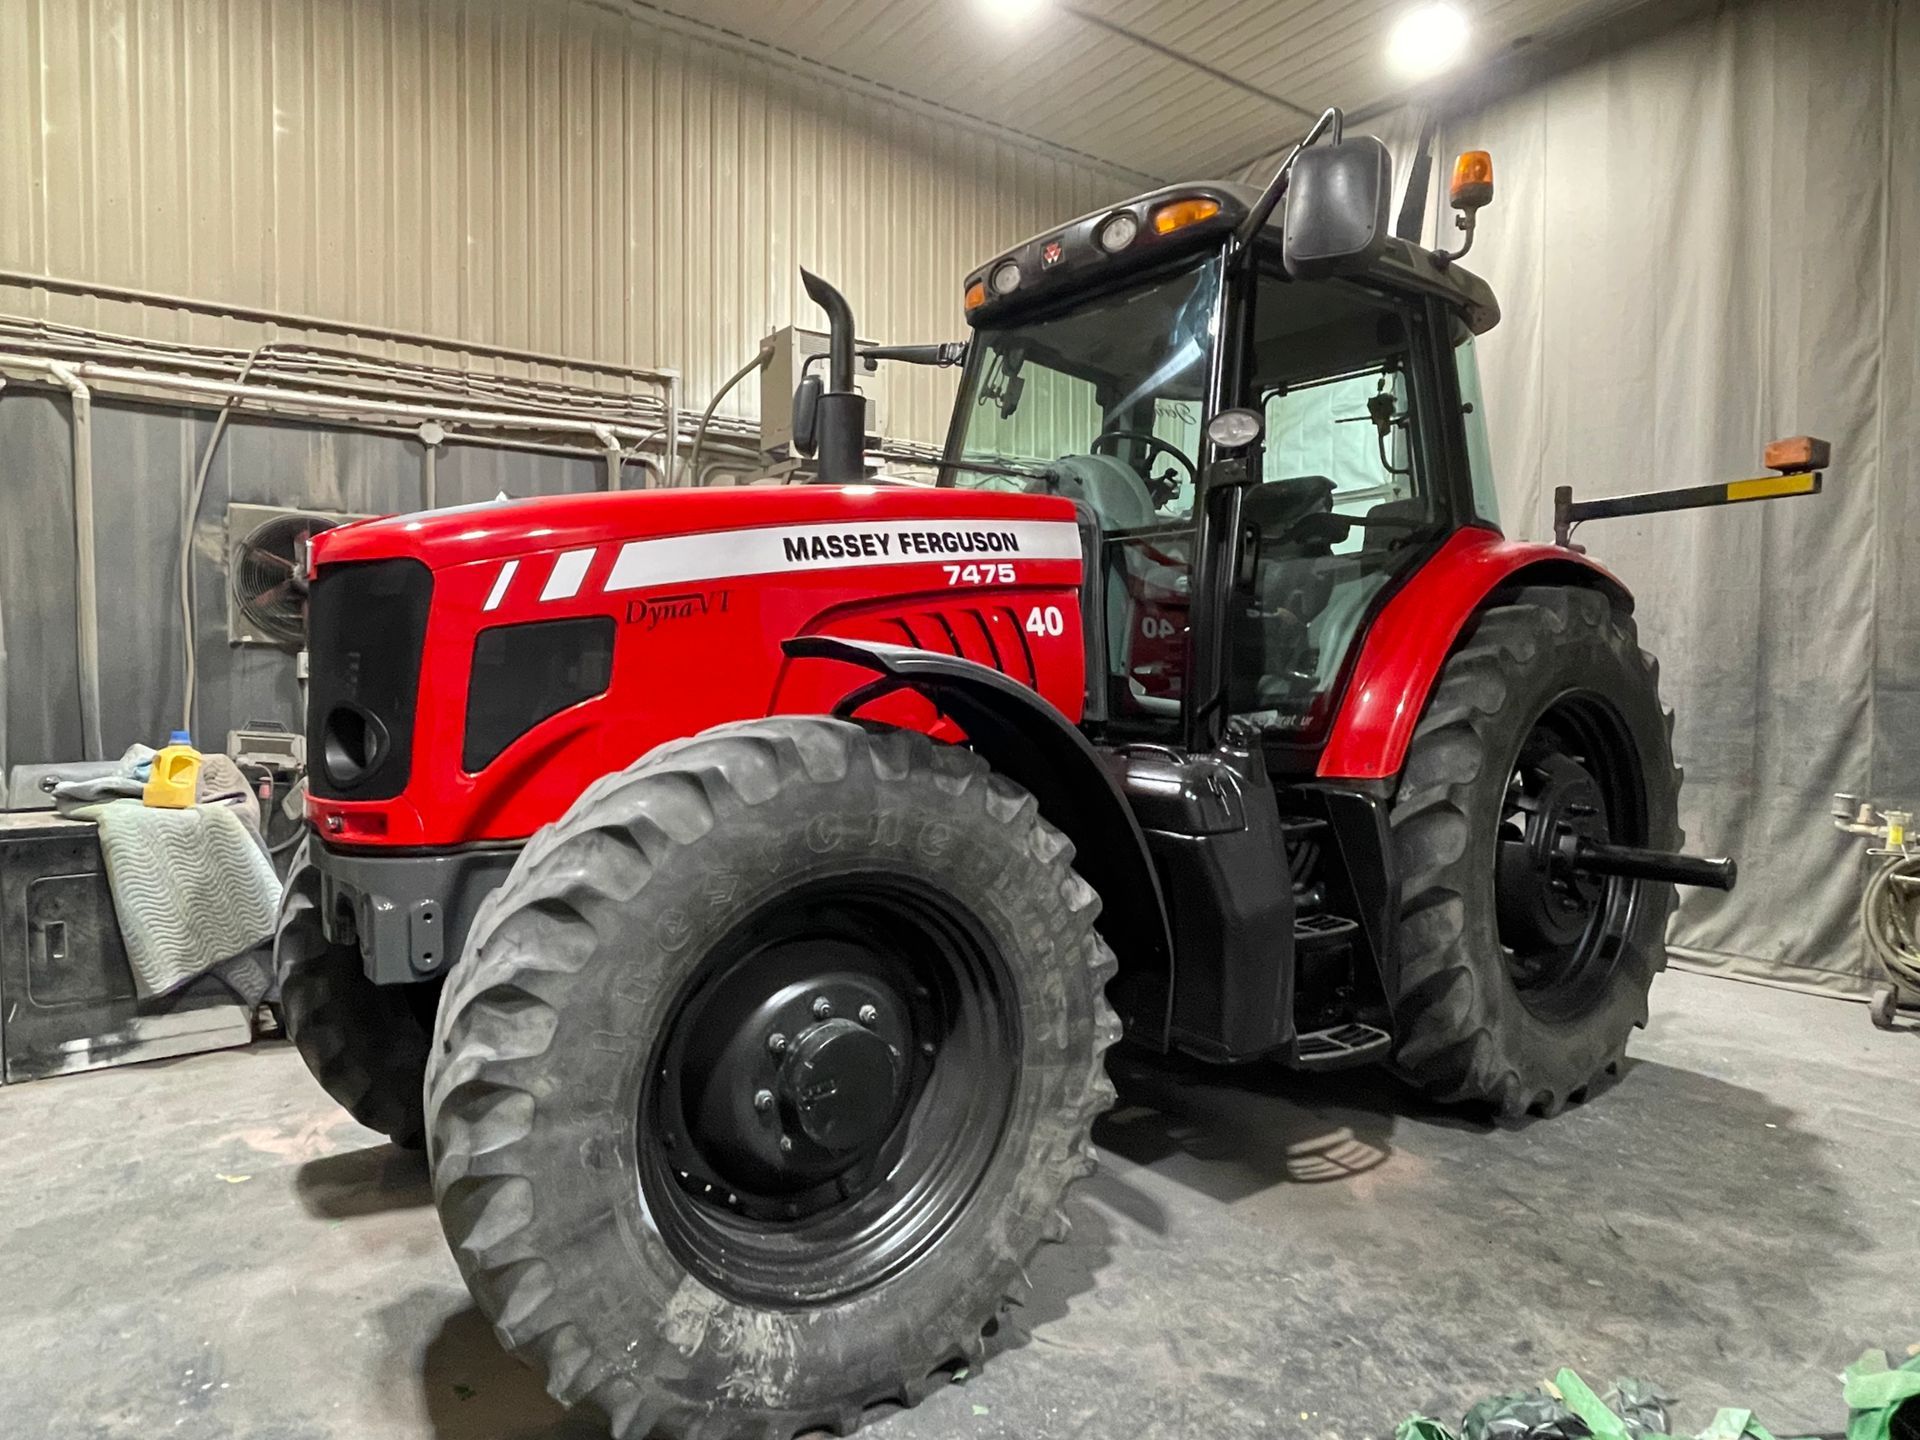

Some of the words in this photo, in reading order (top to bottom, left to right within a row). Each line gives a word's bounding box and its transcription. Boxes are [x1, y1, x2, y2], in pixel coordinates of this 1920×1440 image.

[782, 532, 890, 562] MASSEY
[898, 531, 1020, 555] FERGUSON
[942, 563, 1017, 586] 7475
[1025, 606, 1065, 637] 40
